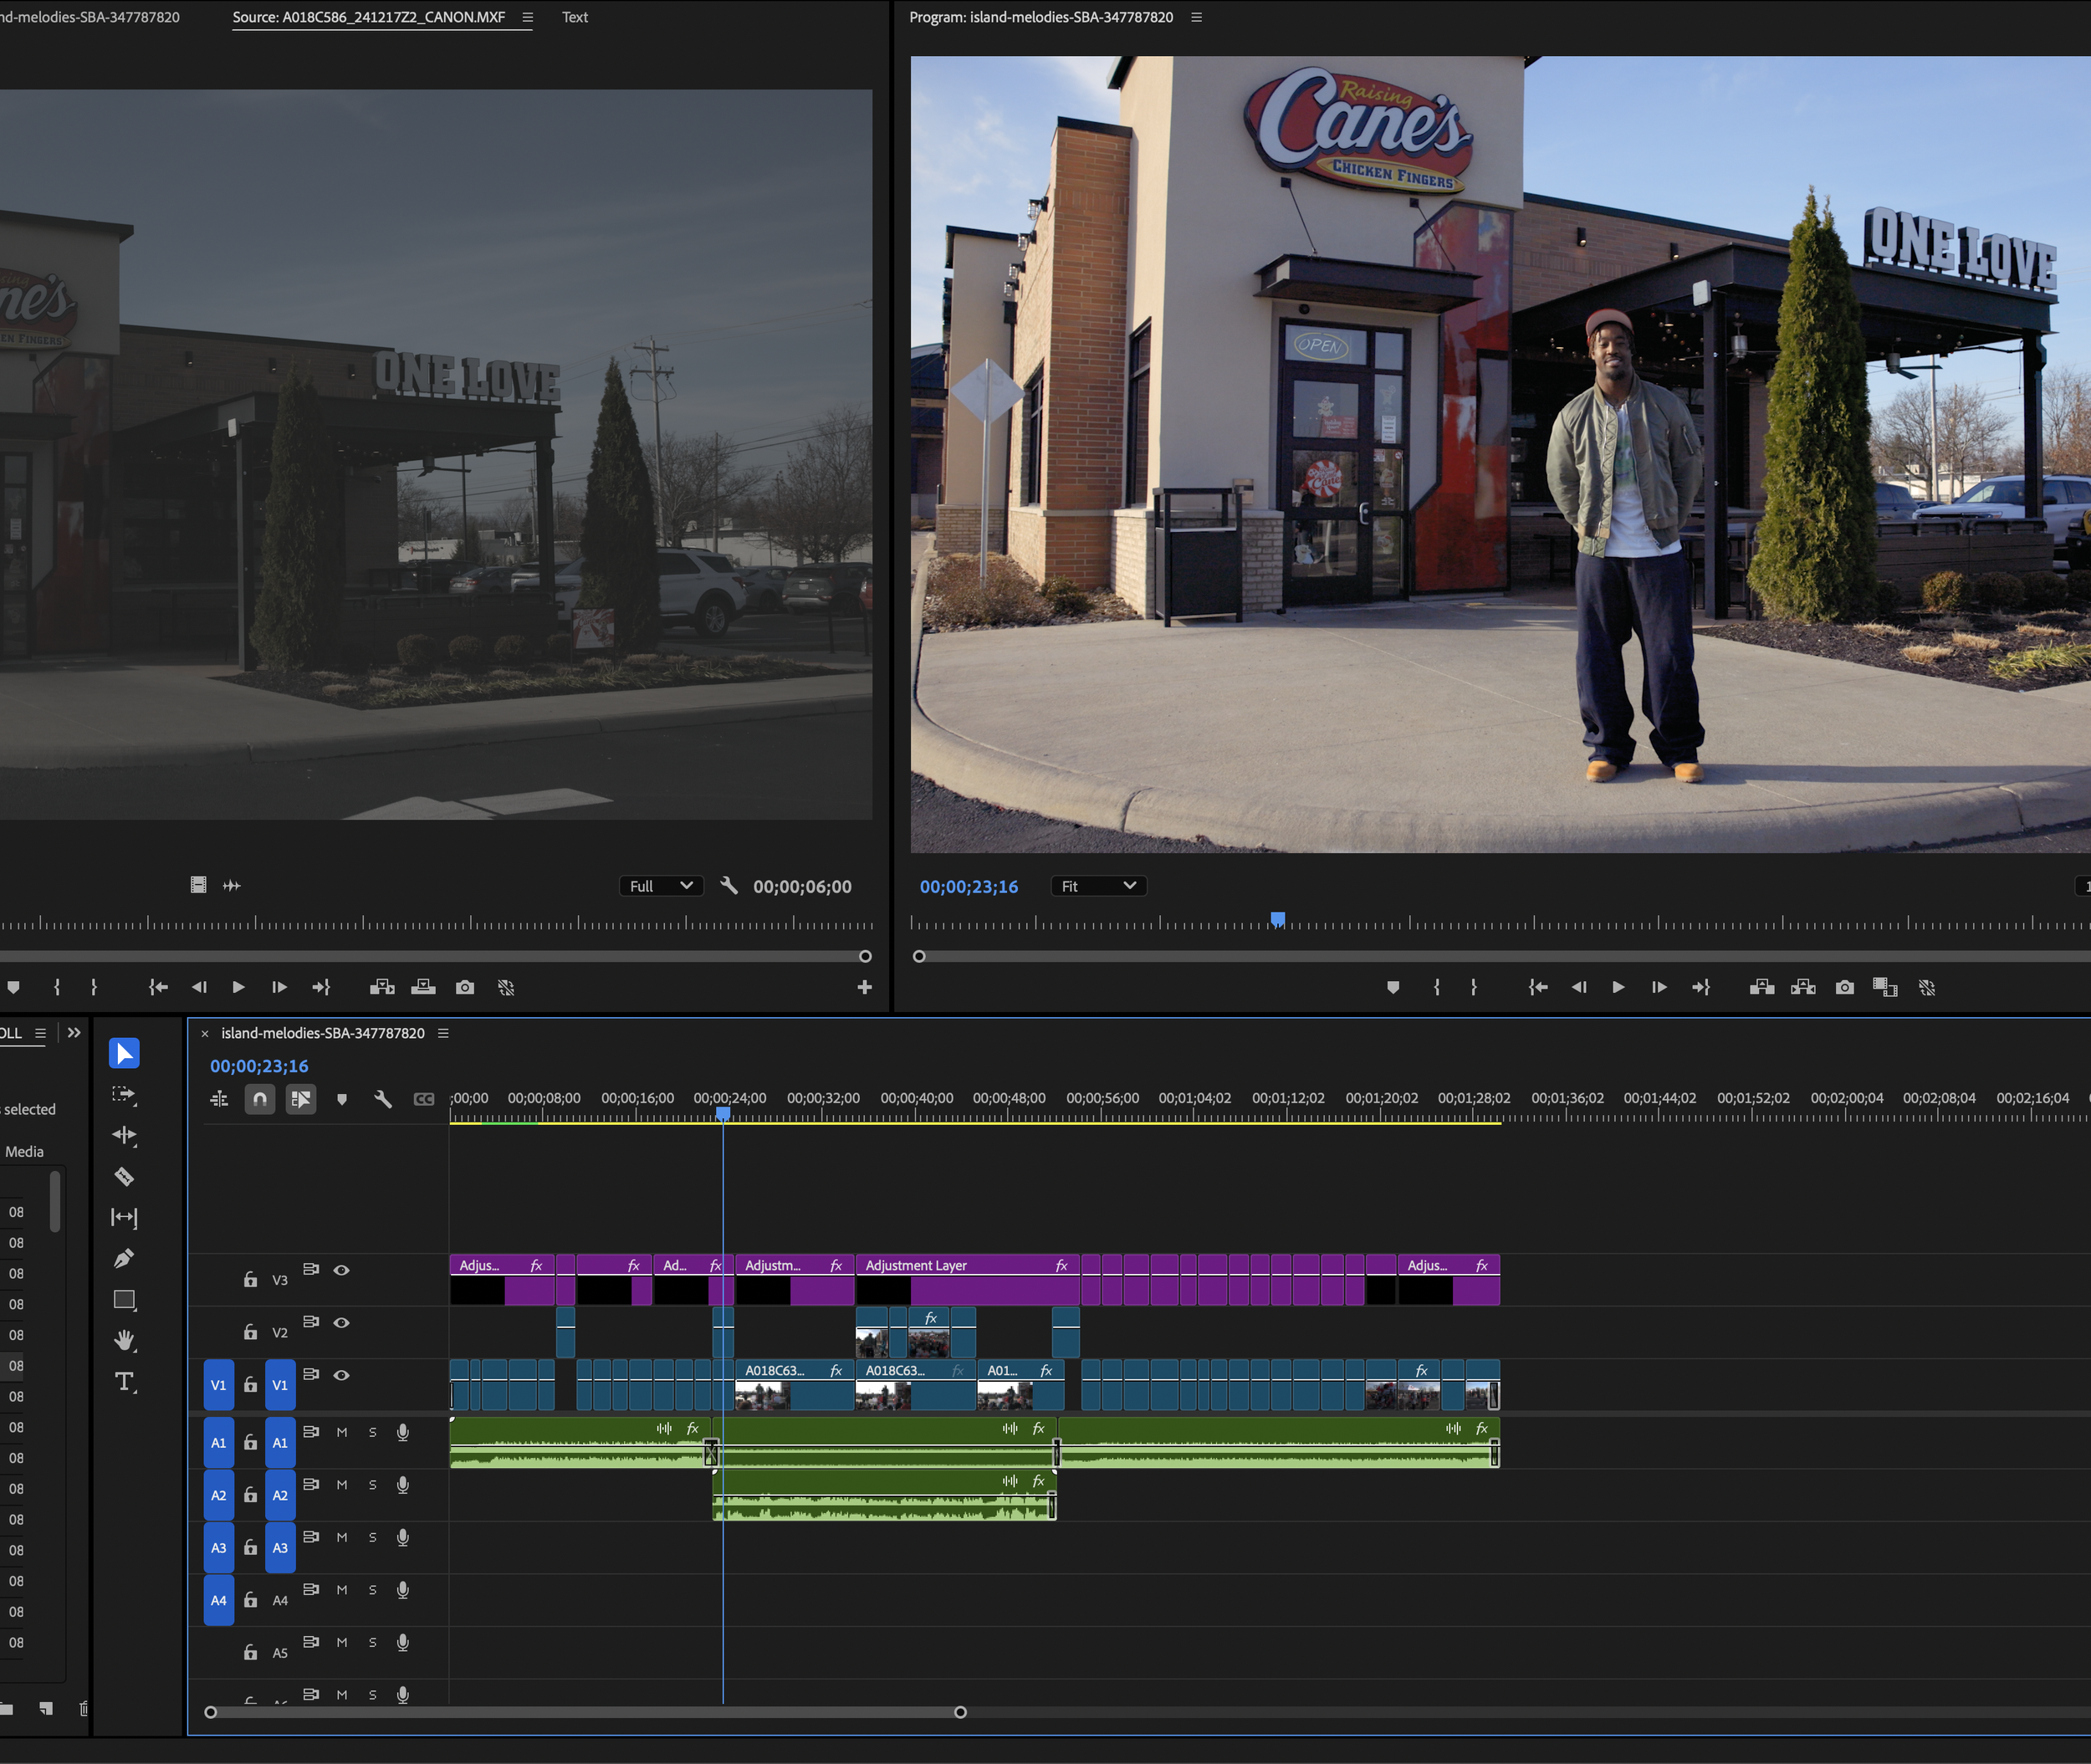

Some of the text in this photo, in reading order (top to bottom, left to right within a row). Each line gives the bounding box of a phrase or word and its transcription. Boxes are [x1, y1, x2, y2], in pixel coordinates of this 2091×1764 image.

[0, 11, 180, 23] nd-melodies-SBA-347787820
[233, 11, 505, 25] Source: A018C586_241217Z2_CANON.MXF
[562, 12, 588, 23] Text
[911, 11, 1173, 26] Program: island-melodies-SBA-347787820
[1339, 80, 1413, 110] Raising
[1260, 66, 1472, 164] Cane's
[1864, 206, 2057, 289] ONE LOVE
[1298, 337, 1342, 355] OPEN
[372, 350, 560, 401] ONE LOVE
[631, 879, 653, 892] Full
[754, 880, 852, 896] 00;00;06;00
[920, 880, 1019, 896] 00;00;23;16
[1063, 880, 1078, 892] Fit
[222, 1026, 426, 1040] island-melodies-SBA-347787820
[211, 1060, 309, 1075] 00;00;23;16
[509, 1092, 580, 1106] 00;00;08;00
[601, 1092, 674, 1106] 00;00;16;00
[694, 1092, 766, 1106] 00;00;24;00
[788, 1092, 860, 1106] 00;00;32;00
[881, 1092, 953, 1106] 00;00;40;00
[974, 1092, 1046, 1106] 00;00;48;00
[1067, 1092, 1139, 1106] 00;00;56;00
[1159, 1092, 1231, 1106] 00;01;04;02
[1253, 1092, 1325, 1106] 00;01;12;02
[1346, 1092, 1419, 1106] 00;01;20;02
[1439, 1092, 1511, 1106] 00;01;28;02
[1532, 1092, 1604, 1106] 00;01;36;02
[1624, 1092, 1696, 1106] 00;01;44;02
[1718, 1092, 1790, 1106] 00;01;52;02
[1812, 1092, 1884, 1106] 00;02;00;04
[1904, 1092, 1976, 1106] 00;02;08;04
[1997, 1092, 2069, 1106] 00;02;16;04
[4, 1102, 56, 1115] selected
[6, 1145, 44, 1158] Media
[8, 1206, 23, 1218] 08
[8, 1236, 23, 1249] 08
[460, 1260, 499, 1274] Adjus...
[530, 1259, 542, 1272] fx
[628, 1259, 640, 1272] fx
[663, 1260, 687, 1271] Ad...
[710, 1259, 722, 1272] fx
[745, 1260, 800, 1274] Adjustm...
[831, 1259, 842, 1272] fx
[866, 1260, 967, 1274] Adjustment Layer
[1056, 1259, 1067, 1272] fx
[1408, 1260, 1447, 1274] Adjus...
[1476, 1259, 1488, 1272] fx
[8, 1267, 23, 1280] 08
[273, 1276, 288, 1286] V3
[8, 1298, 23, 1311] 08
[925, 1311, 937, 1325] fx
[8, 1329, 23, 1341] 08
[273, 1327, 288, 1337] V2
[8, 1360, 23, 1372] 08
[745, 1364, 805, 1377] A018C63...
[831, 1364, 842, 1378] fx
[866, 1364, 925, 1377] A018C63...
[953, 1364, 964, 1378] fx
[988, 1364, 1018, 1377] A01...
[1040, 1364, 1052, 1378] fx
[1416, 1364, 1428, 1378] fx
[211, 1380, 226, 1390] V1
[273, 1380, 288, 1390] V1
[8, 1390, 23, 1403] 08
[8, 1421, 23, 1434] 08
[337, 1428, 347, 1437] M
[370, 1428, 376, 1437] S
[687, 1422, 699, 1436] fx
[1033, 1422, 1045, 1436] fx
[1476, 1422, 1488, 1436] fx
[212, 1438, 226, 1448] A1
[273, 1438, 288, 1448] A1
[8, 1452, 23, 1465] 08
[337, 1480, 347, 1490] M
[370, 1480, 376, 1490] S
[1033, 1475, 1045, 1489] fx
[8, 1483, 23, 1495] 08
[212, 1490, 227, 1501] A2
[273, 1490, 288, 1501] A2
[8, 1513, 23, 1526] 08
[337, 1532, 347, 1542] M
[370, 1533, 376, 1542] S
[8, 1544, 23, 1557] 08
[211, 1543, 227, 1553] A3
[273, 1543, 288, 1553] A3
[8, 1575, 23, 1588] 08
[337, 1585, 347, 1594] M
[370, 1585, 376, 1594] S
[211, 1595, 227, 1606] A4
[273, 1596, 288, 1605] A4
[8, 1606, 23, 1618] 08
[8, 1636, 23, 1649] 08
[337, 1638, 347, 1647] M
[370, 1638, 376, 1647] S
[273, 1648, 288, 1658] A5
[337, 1690, 347, 1700] M
[370, 1690, 376, 1700] S
